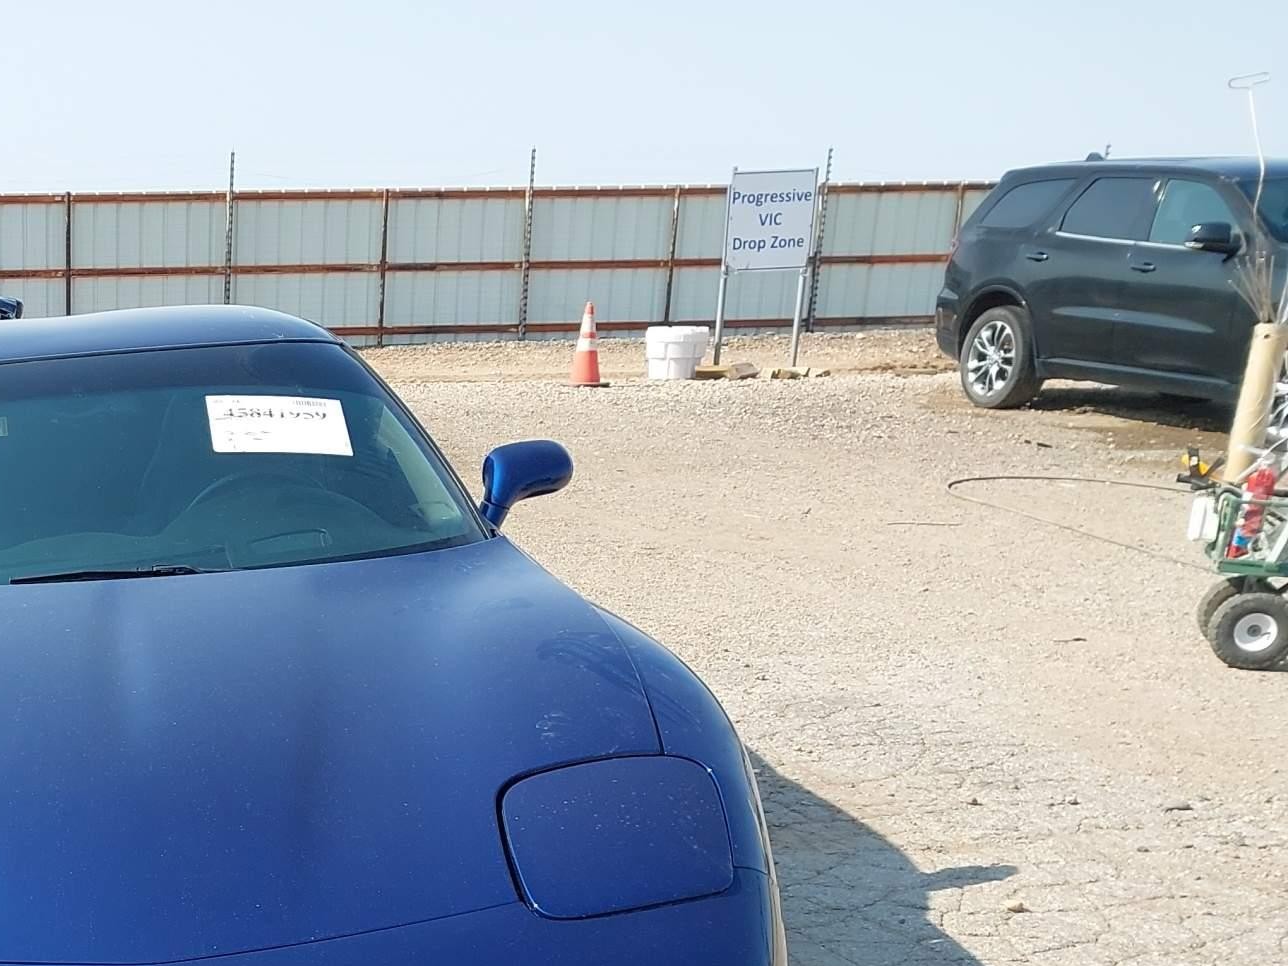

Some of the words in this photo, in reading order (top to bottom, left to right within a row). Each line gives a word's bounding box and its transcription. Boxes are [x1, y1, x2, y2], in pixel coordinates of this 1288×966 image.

[732, 188, 813, 206] Progressive
[758, 212, 783, 226] VIC
[732, 237, 766, 252] Drop
[770, 236, 805, 249] Zone
